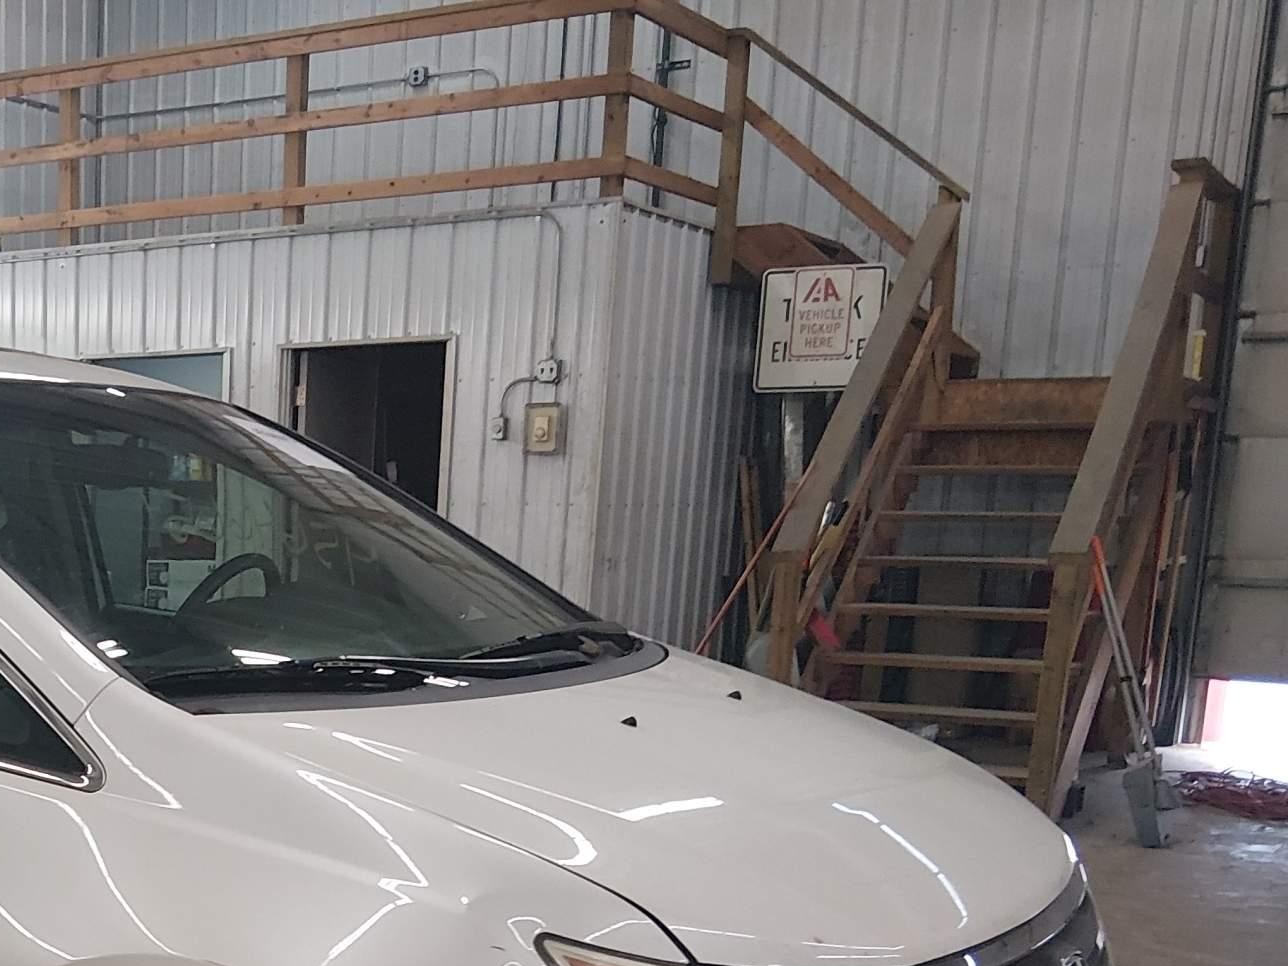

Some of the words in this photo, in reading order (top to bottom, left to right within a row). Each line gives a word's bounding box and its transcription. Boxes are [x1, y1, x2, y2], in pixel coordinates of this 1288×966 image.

[799, 308, 844, 320] VEHICLE
[799, 322, 841, 334] PICKUP
[804, 336, 833, 348] HERE
